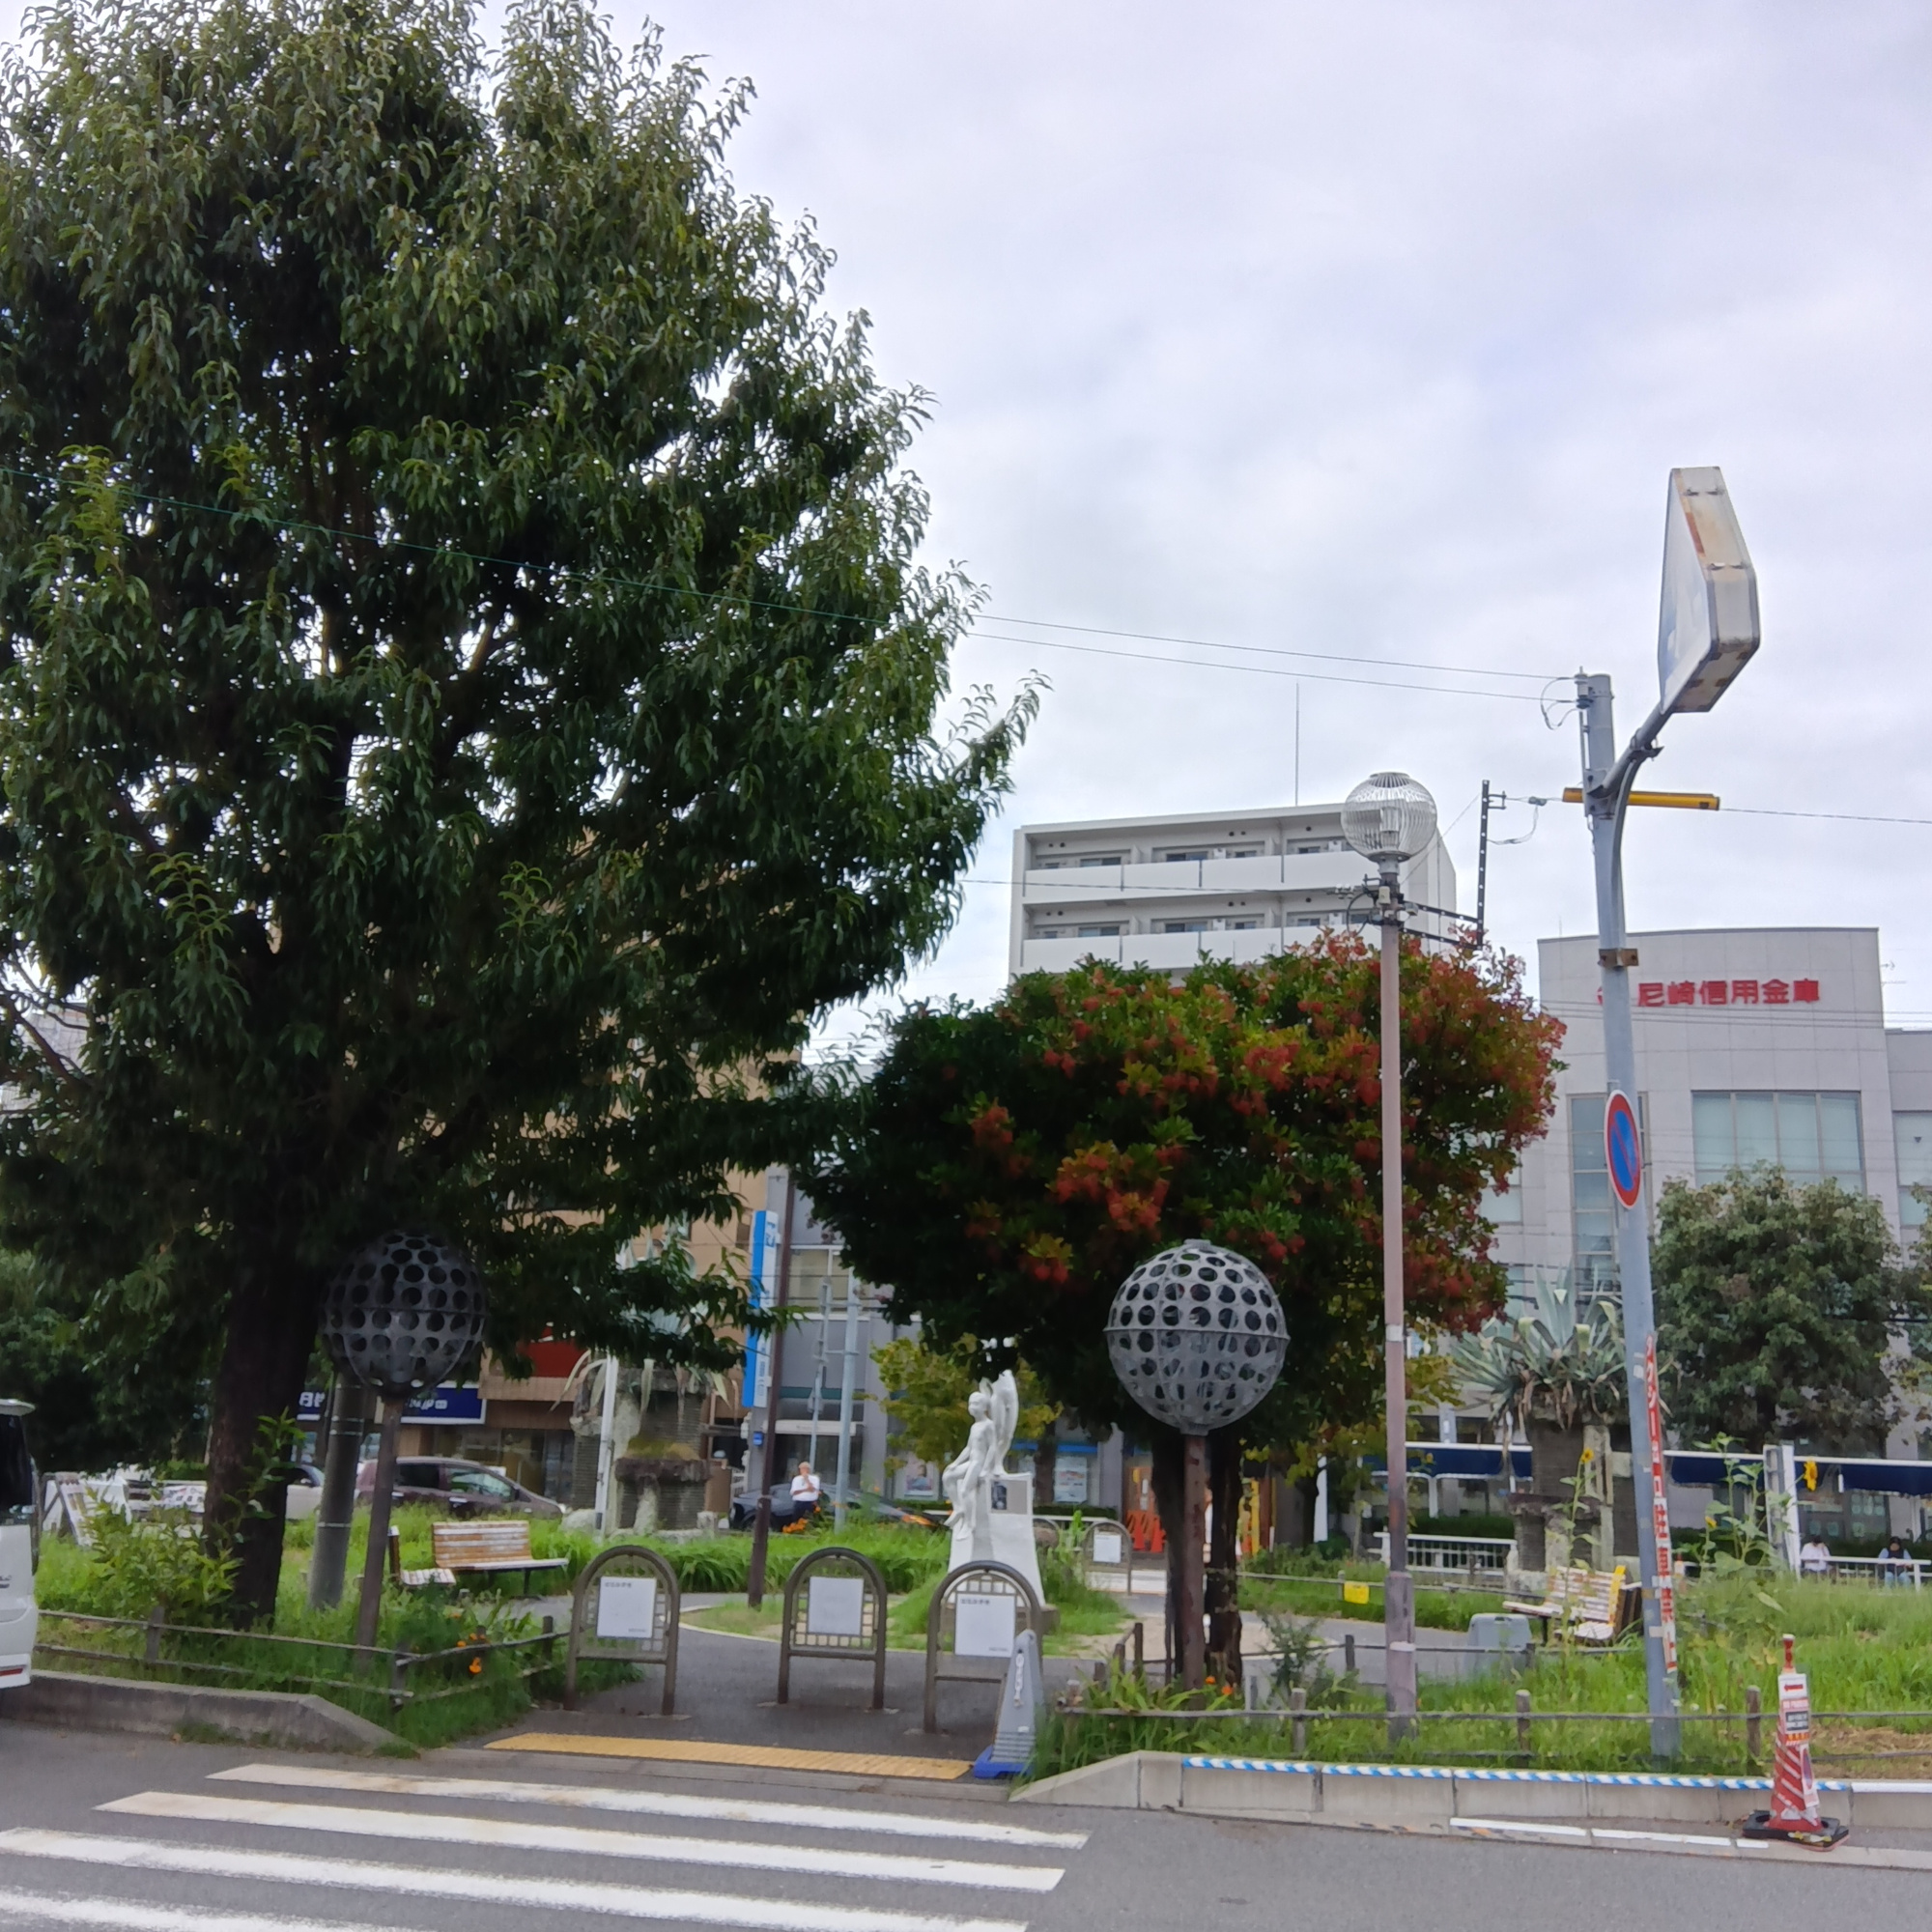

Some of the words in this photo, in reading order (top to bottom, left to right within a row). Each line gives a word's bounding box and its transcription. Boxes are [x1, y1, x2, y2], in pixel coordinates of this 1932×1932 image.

[1638, 978, 1820, 1008] 尼崎信用金庫
